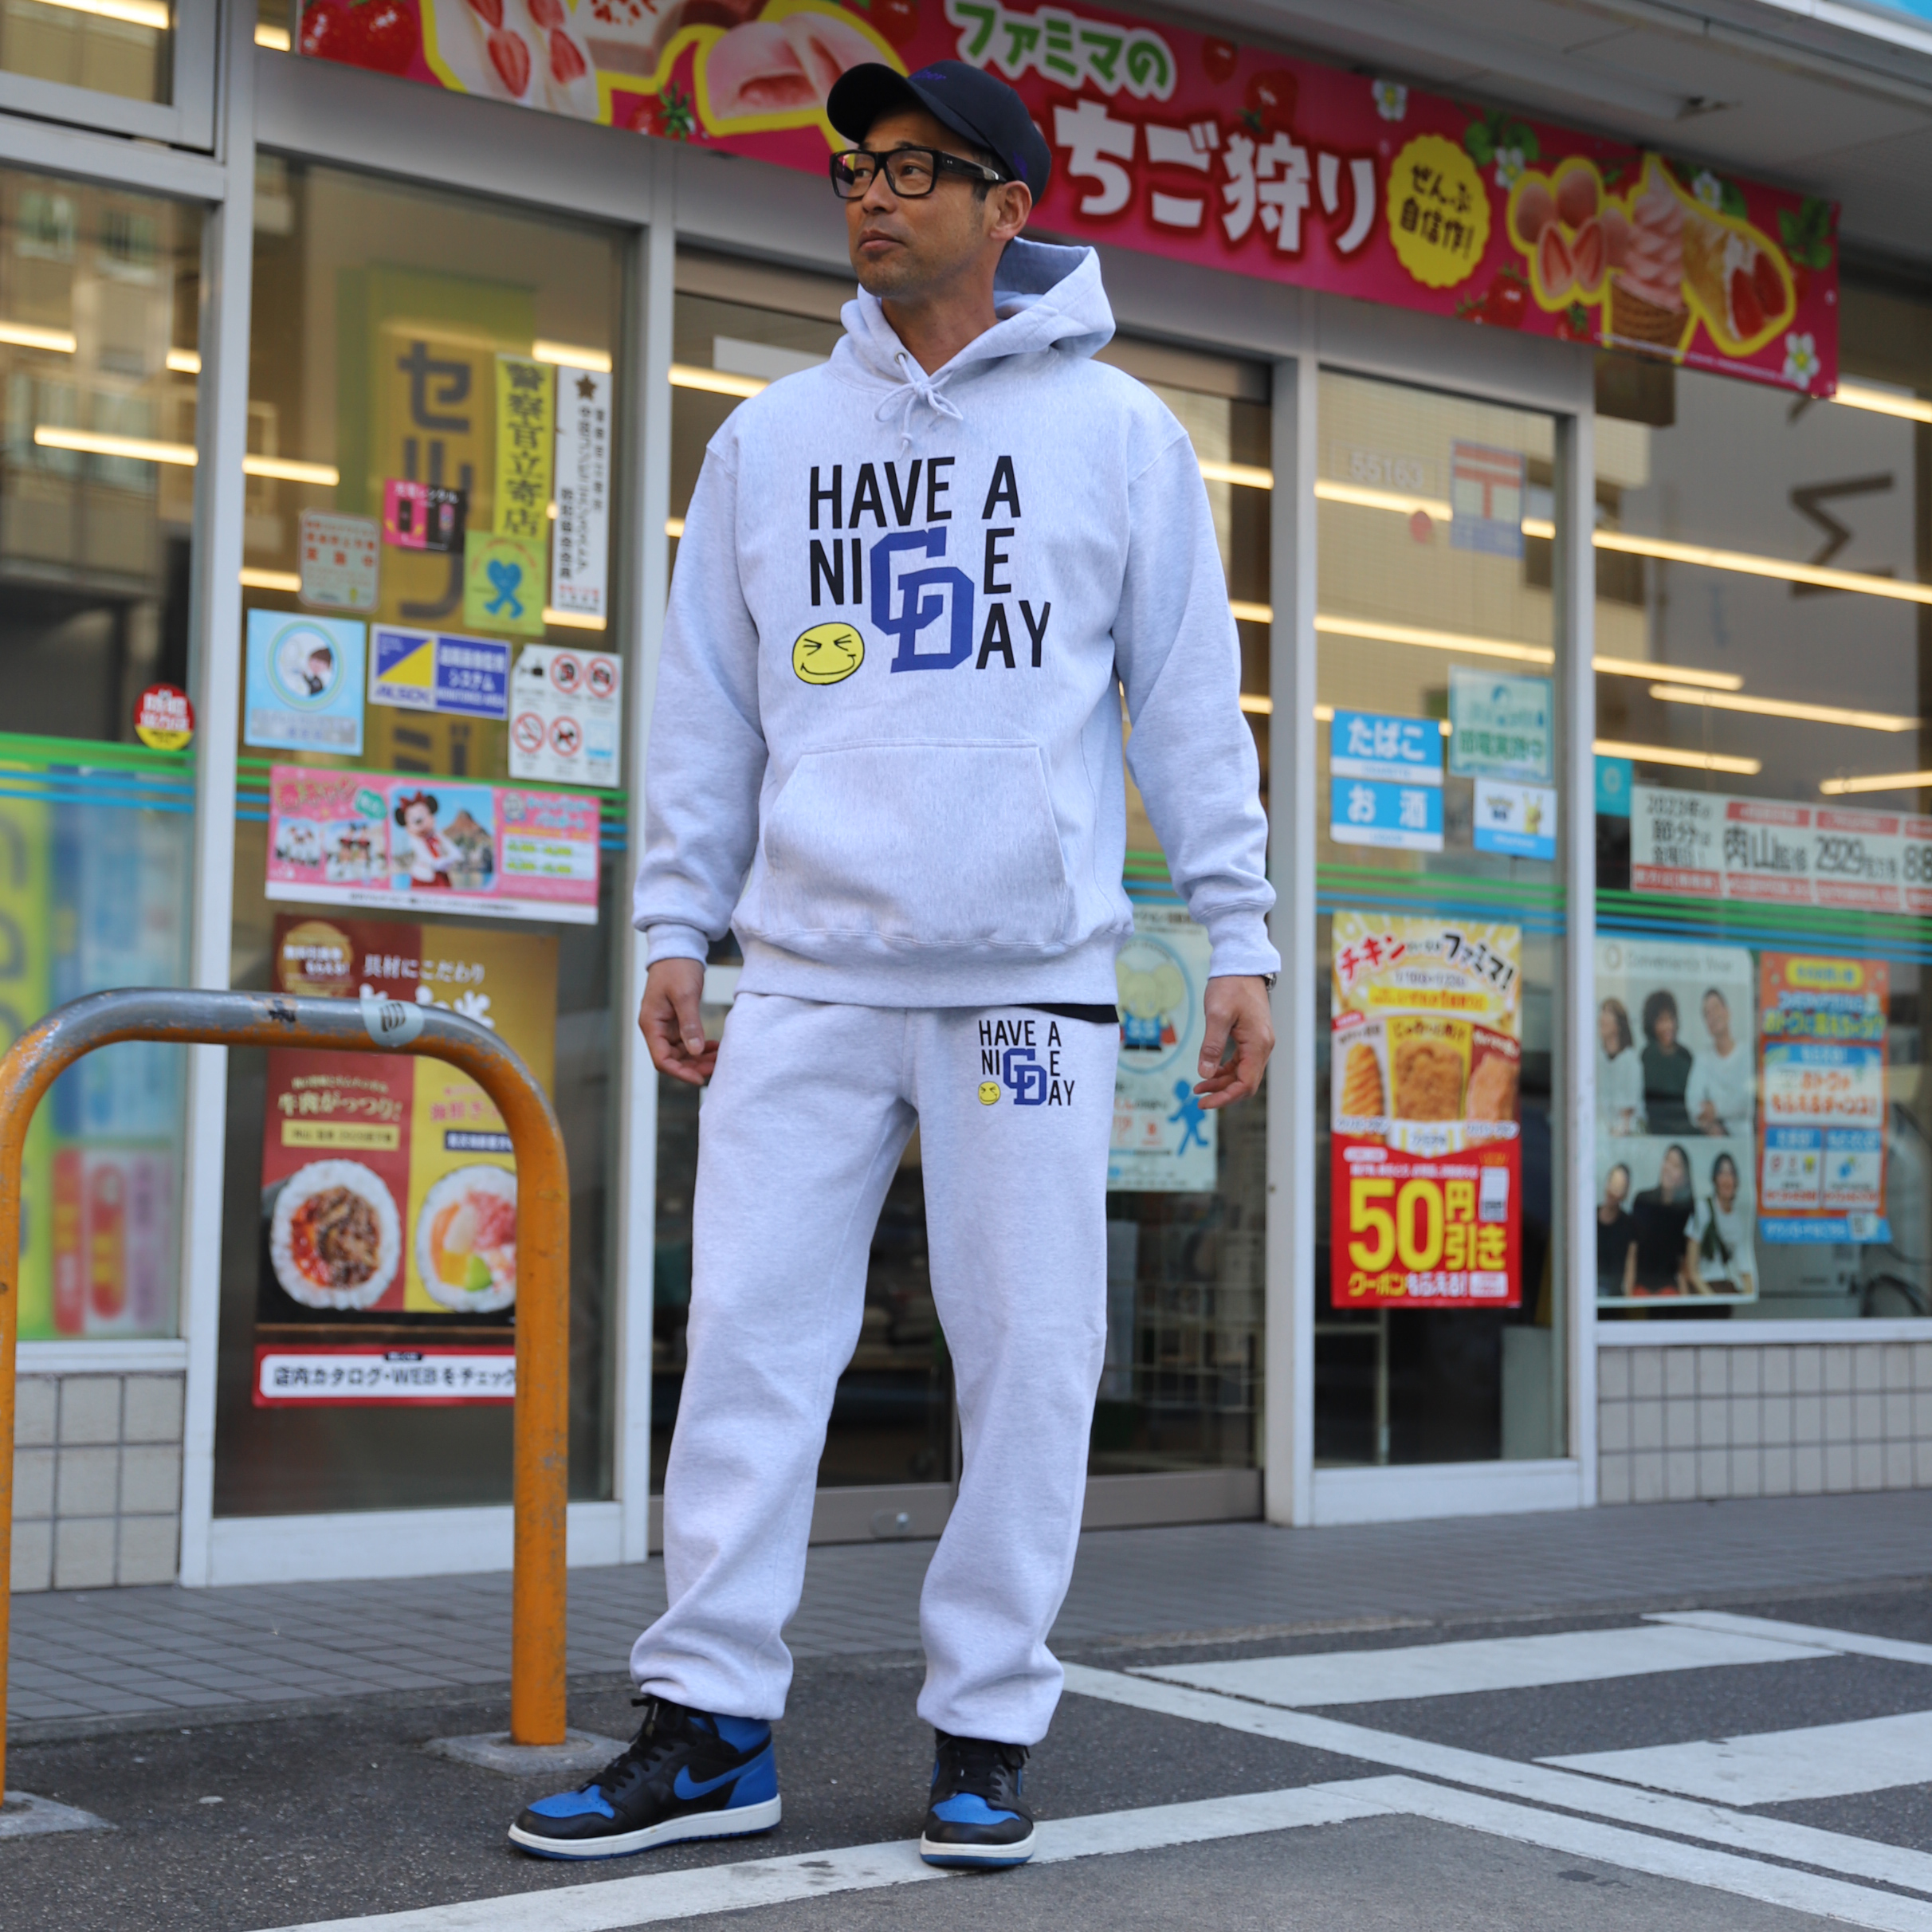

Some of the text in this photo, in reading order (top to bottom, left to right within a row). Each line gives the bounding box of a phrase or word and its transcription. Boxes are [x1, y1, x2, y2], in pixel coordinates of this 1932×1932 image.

[955, 2, 1168, 88] ファミマの
[1036, 99, 1376, 253] ちご狩り
[809, 455, 1021, 529] HAVE A
[1347, 716, 1426, 762] たばこ
[364, 954, 485, 984] 具材にこだわり
[1342, 933, 1514, 990] チキン ファミマ!
[979, 1020, 1062, 1046] HAVE A
